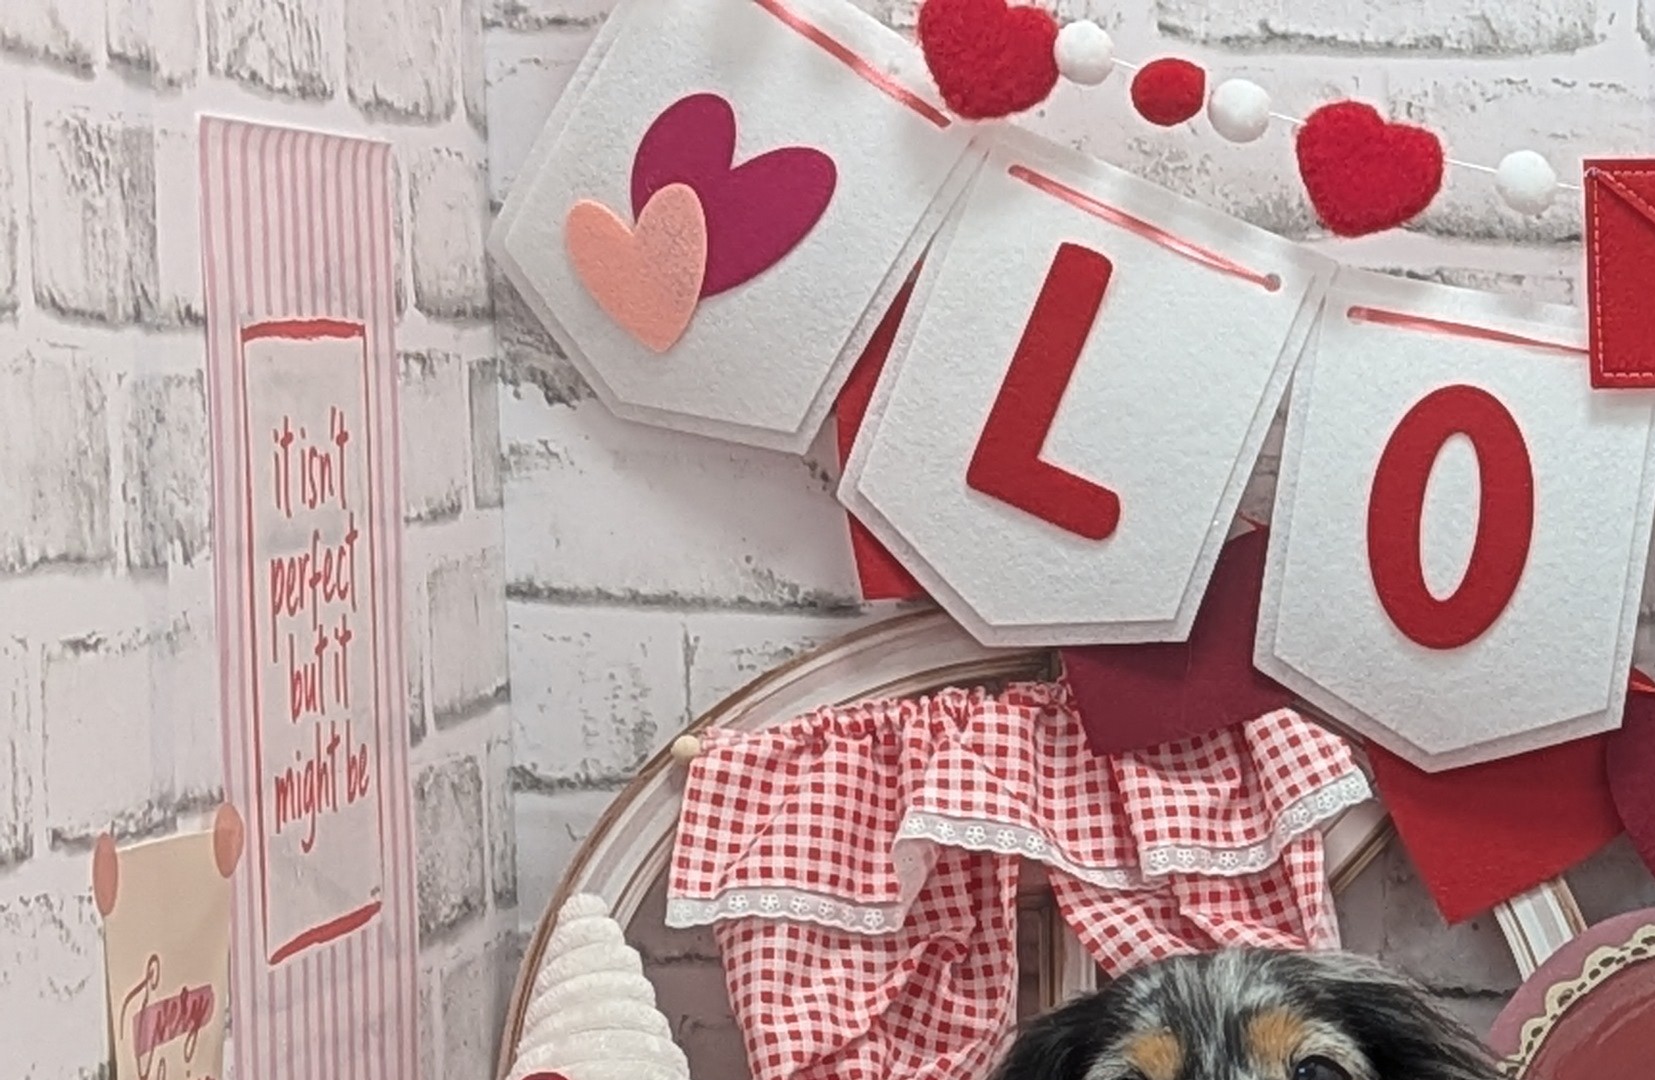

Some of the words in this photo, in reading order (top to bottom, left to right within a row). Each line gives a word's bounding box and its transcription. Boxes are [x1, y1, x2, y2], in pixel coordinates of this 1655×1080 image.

[274, 415, 294, 519] it
[301, 406, 349, 510] isn't
[270, 511, 359, 664] perfect
[289, 624, 329, 724] but
[334, 613, 352, 710] it
[275, 720, 341, 854] might
[345, 719, 370, 804] be
